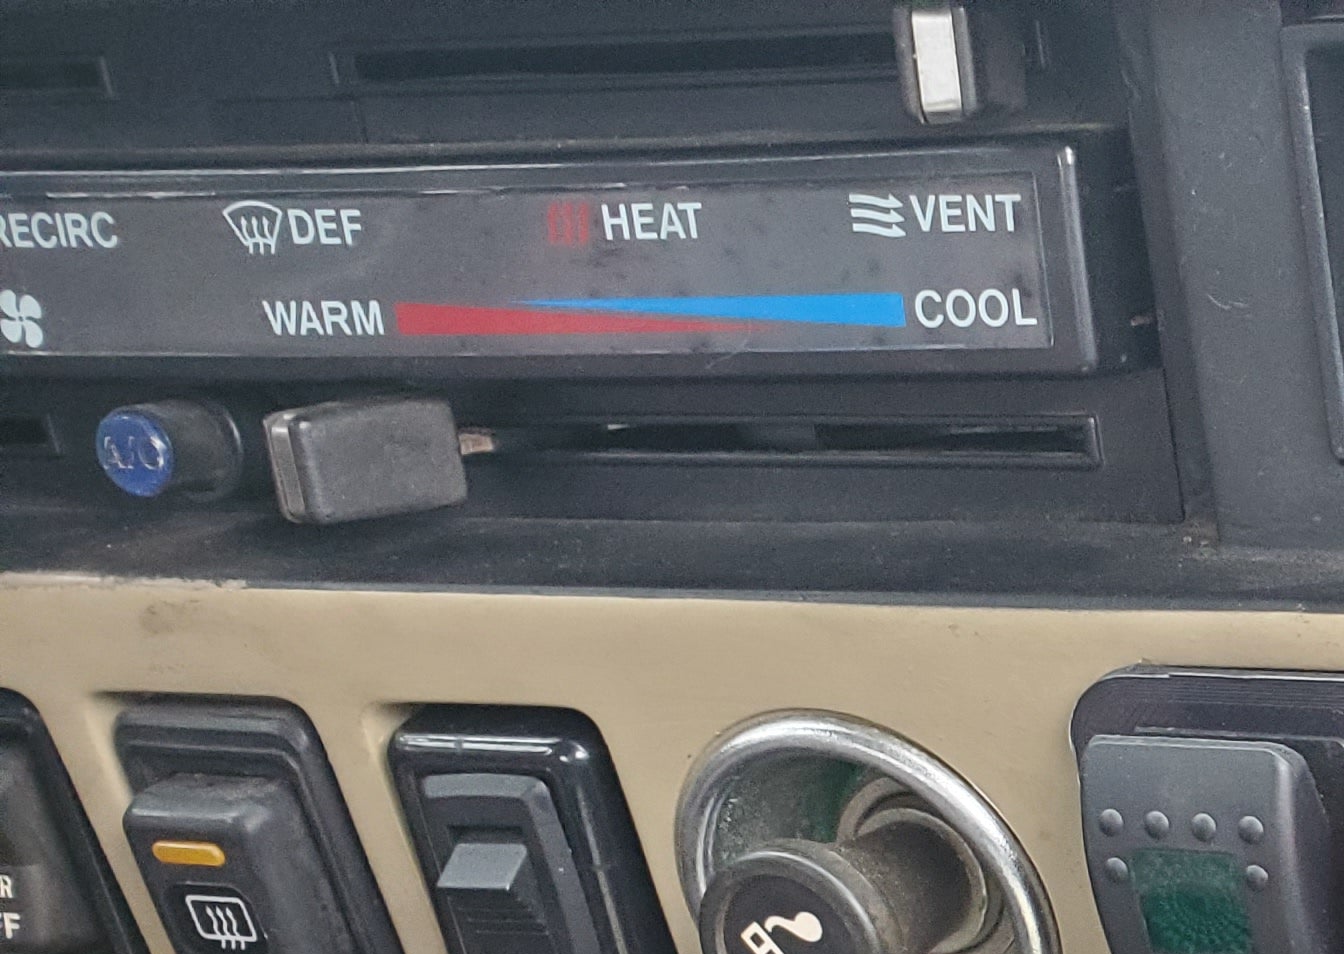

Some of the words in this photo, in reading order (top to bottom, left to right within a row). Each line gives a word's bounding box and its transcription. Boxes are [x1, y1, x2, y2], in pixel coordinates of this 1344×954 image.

[287, 208, 362, 247] DEF
[601, 201, 703, 241] HEAT
[908, 193, 1021, 233] VENT
[262, 299, 385, 336] WARM
[914, 288, 1038, 329] COOL
